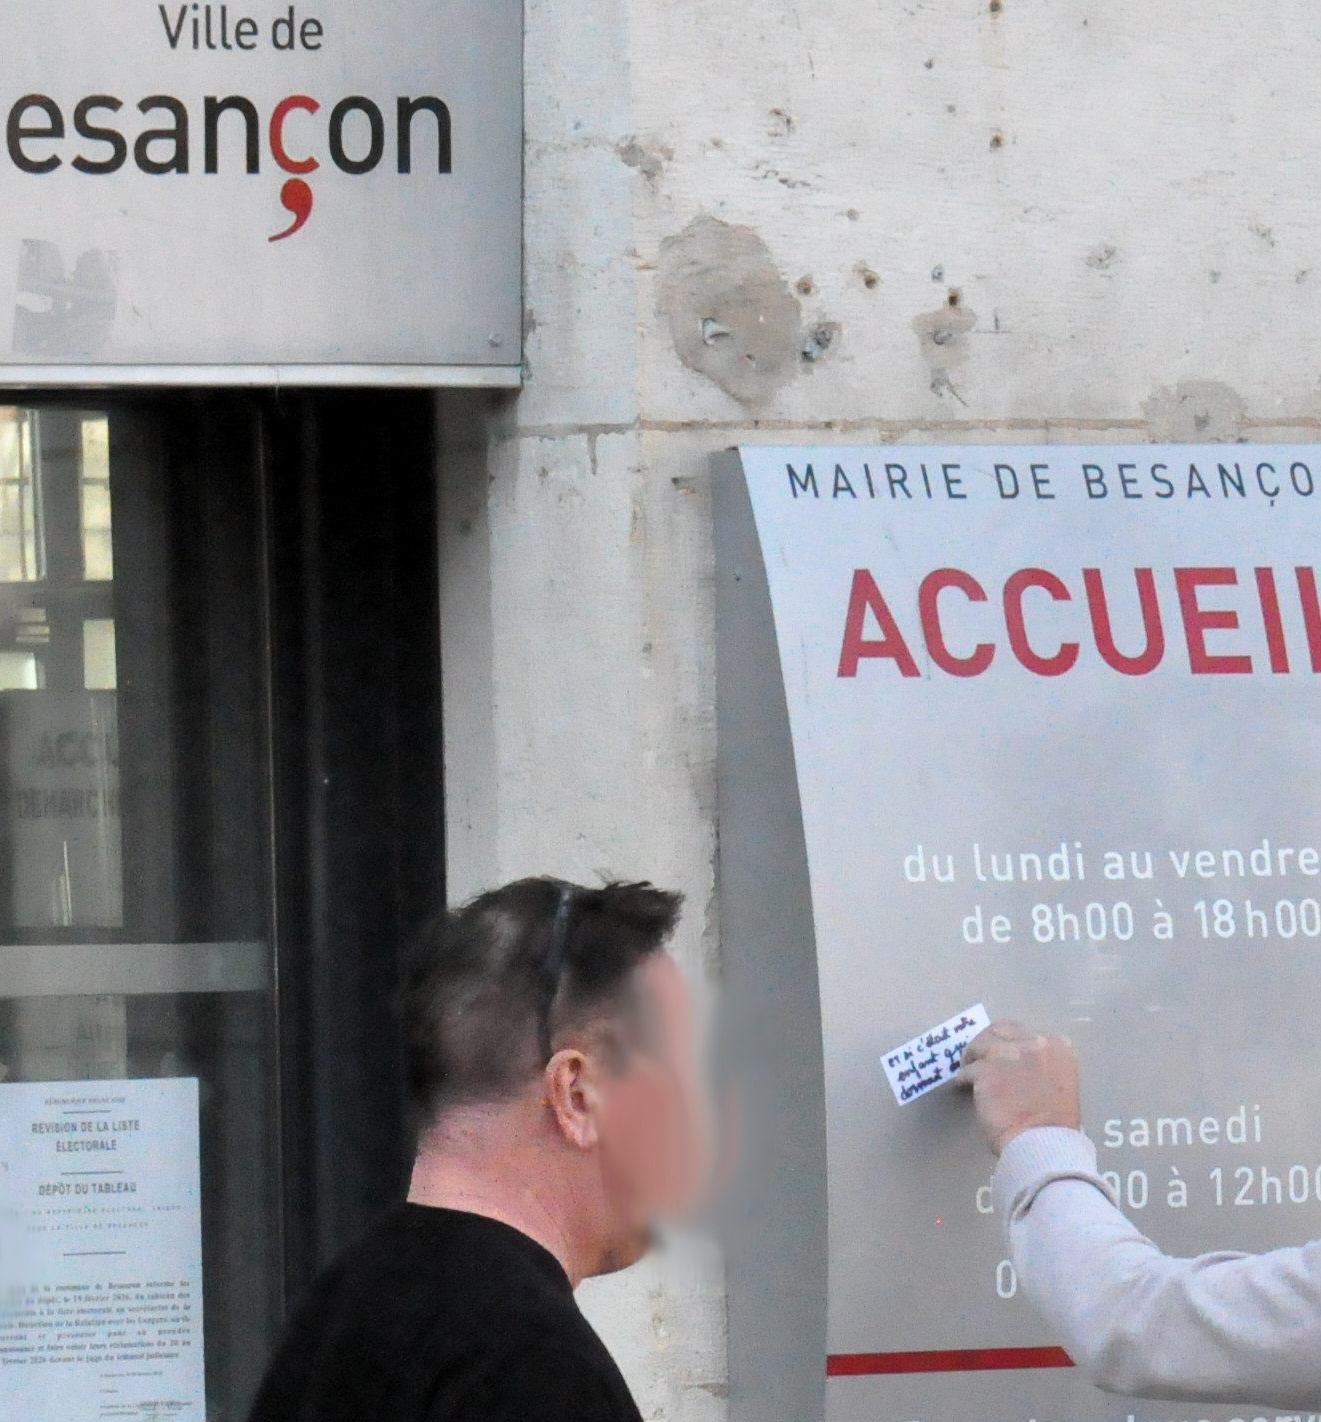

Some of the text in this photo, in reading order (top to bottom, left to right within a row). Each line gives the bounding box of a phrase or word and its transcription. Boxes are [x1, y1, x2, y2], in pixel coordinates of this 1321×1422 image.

[158, 3, 324, 51] Ville de
[785, 463, 969, 500] MAIRIE
[993, 463, 1057, 500] DE
[902, 843, 956, 884] du
[972, 840, 1086, 883] lundi
[1102, 850, 1154, 881] au
[961, 904, 1012, 945] de
[1031, 900, 1135, 944] 8h00
[1152, 897, 1175, 941] à
[1103, 1102, 1263, 1149] samedi
[1166, 1165, 1189, 1209] à
